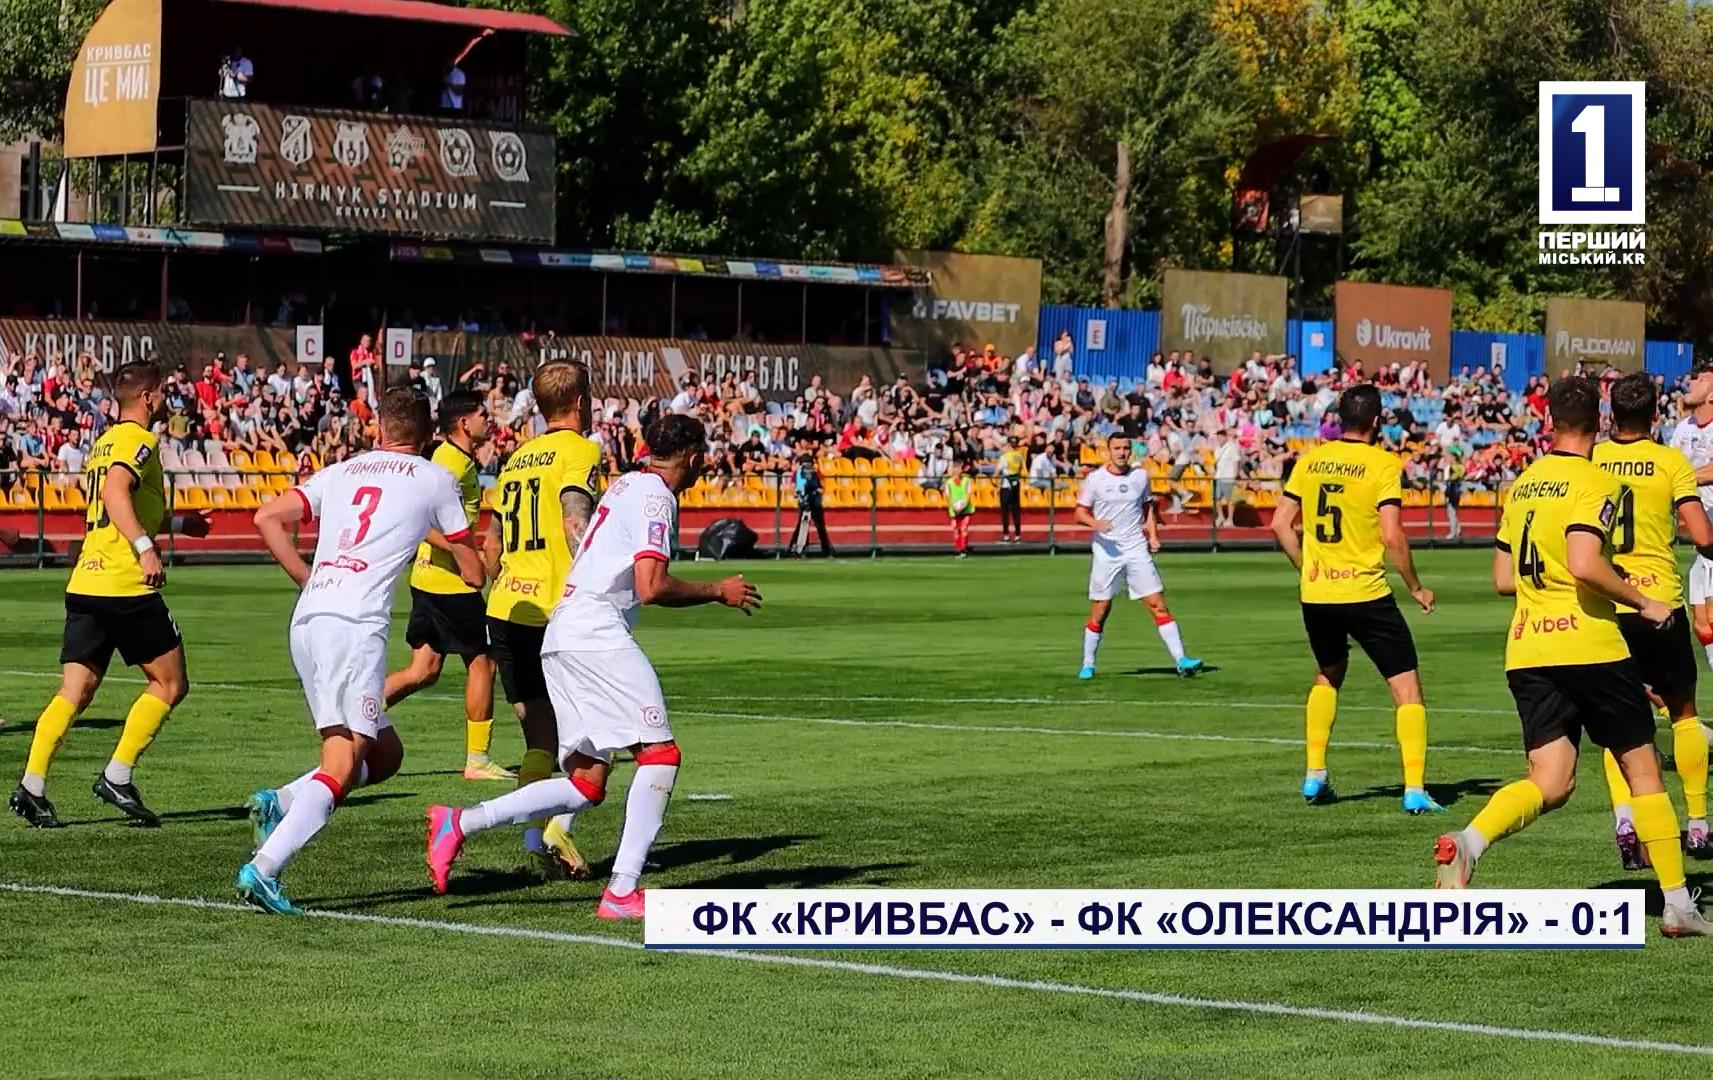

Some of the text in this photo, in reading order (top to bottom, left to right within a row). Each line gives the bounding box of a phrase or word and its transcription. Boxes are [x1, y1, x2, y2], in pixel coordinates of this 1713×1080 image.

[87, 43, 151, 61] КРИВБАС
[85, 66, 110, 107] ЦЕ
[275, 181, 477, 209] HIRNYK STADIUM
[932, 300, 1020, 323] FAVBET
[305, 338, 316, 356] C
[394, 341, 405, 358] D
[1375, 324, 1431, 351] Ukravit
[605, 350, 654, 386] НАМ
[345, 460, 418, 478] РОМАНЧУК
[352, 486, 383, 545] 3
[503, 478, 546, 553] 31
[1316, 483, 1344, 543] 5
[1518, 510, 1546, 590] 4
[1323, 567, 1361, 580] vbet
[1532, 614, 1579, 634] vbet
